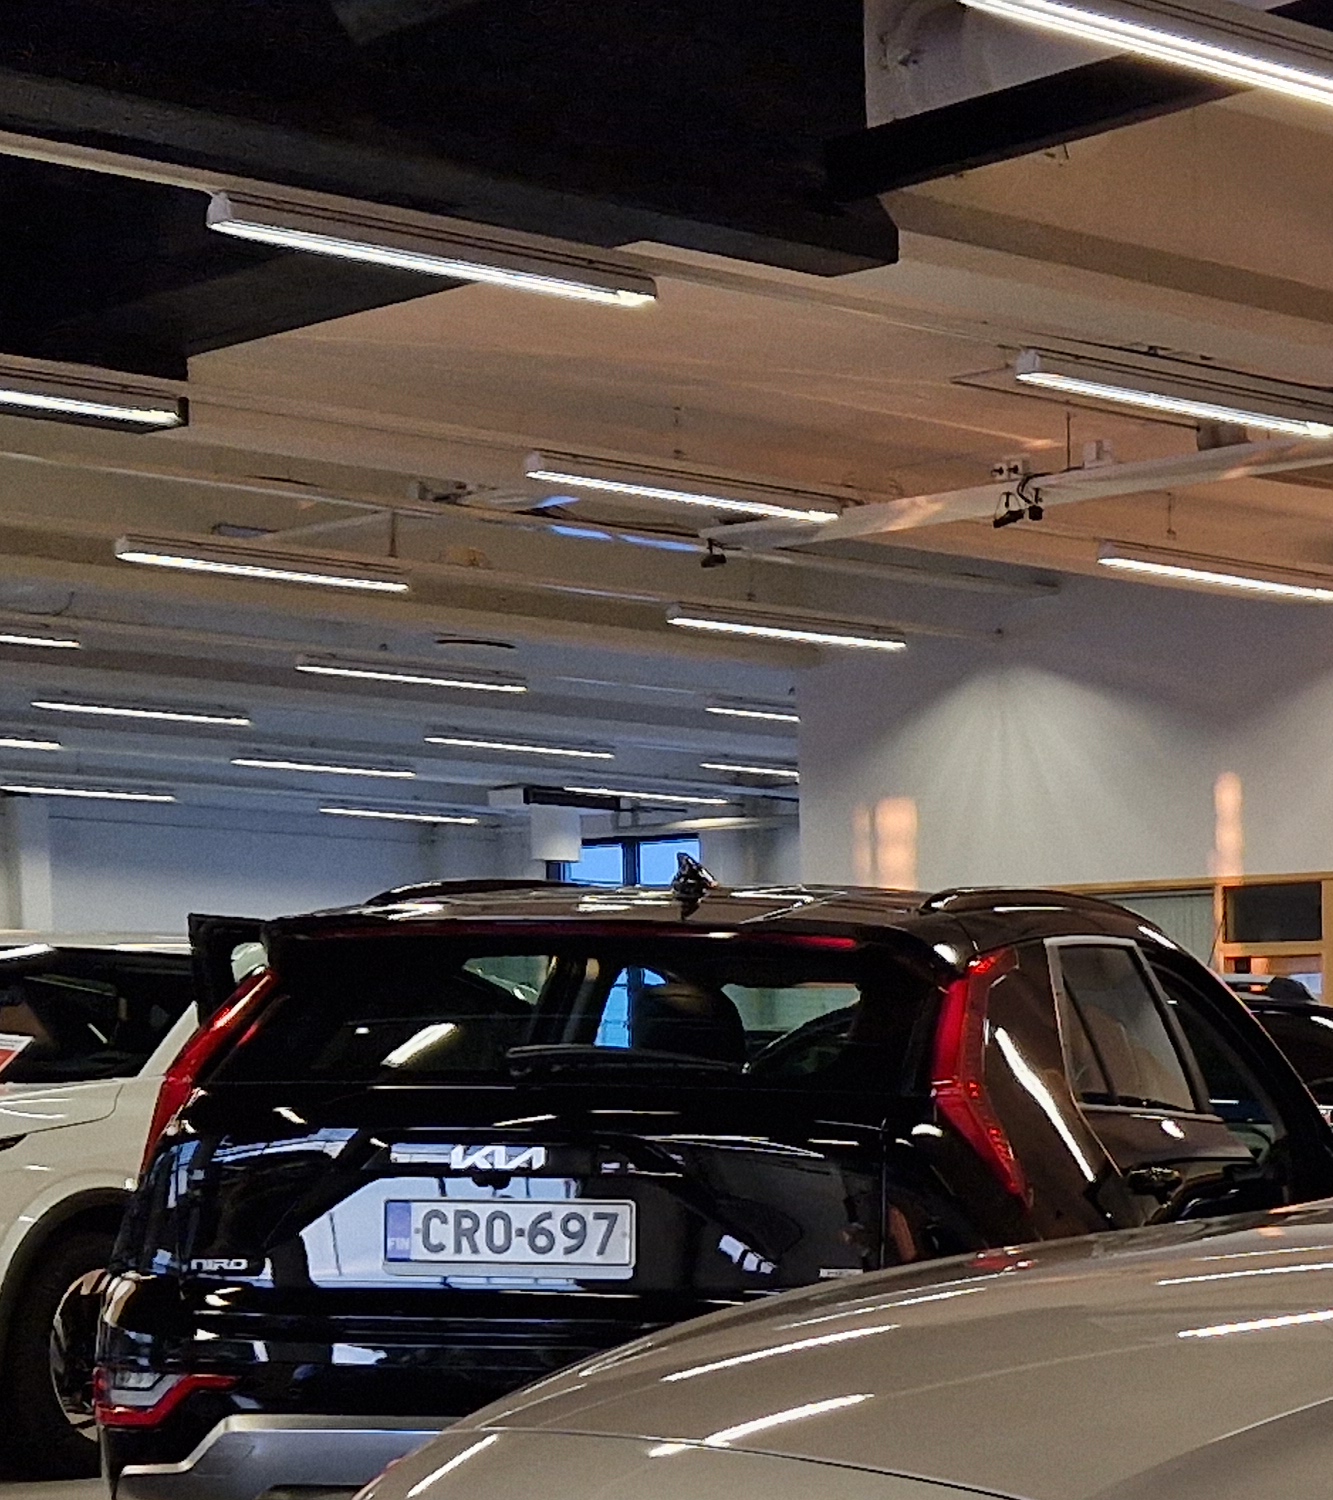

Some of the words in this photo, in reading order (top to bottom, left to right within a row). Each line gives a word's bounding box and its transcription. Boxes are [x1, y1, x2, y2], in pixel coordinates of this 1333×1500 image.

[450, 1145, 546, 1170] KIA
[421, 1209, 619, 1256] CRO-697
[190, 1258, 249, 1271] NIRO
